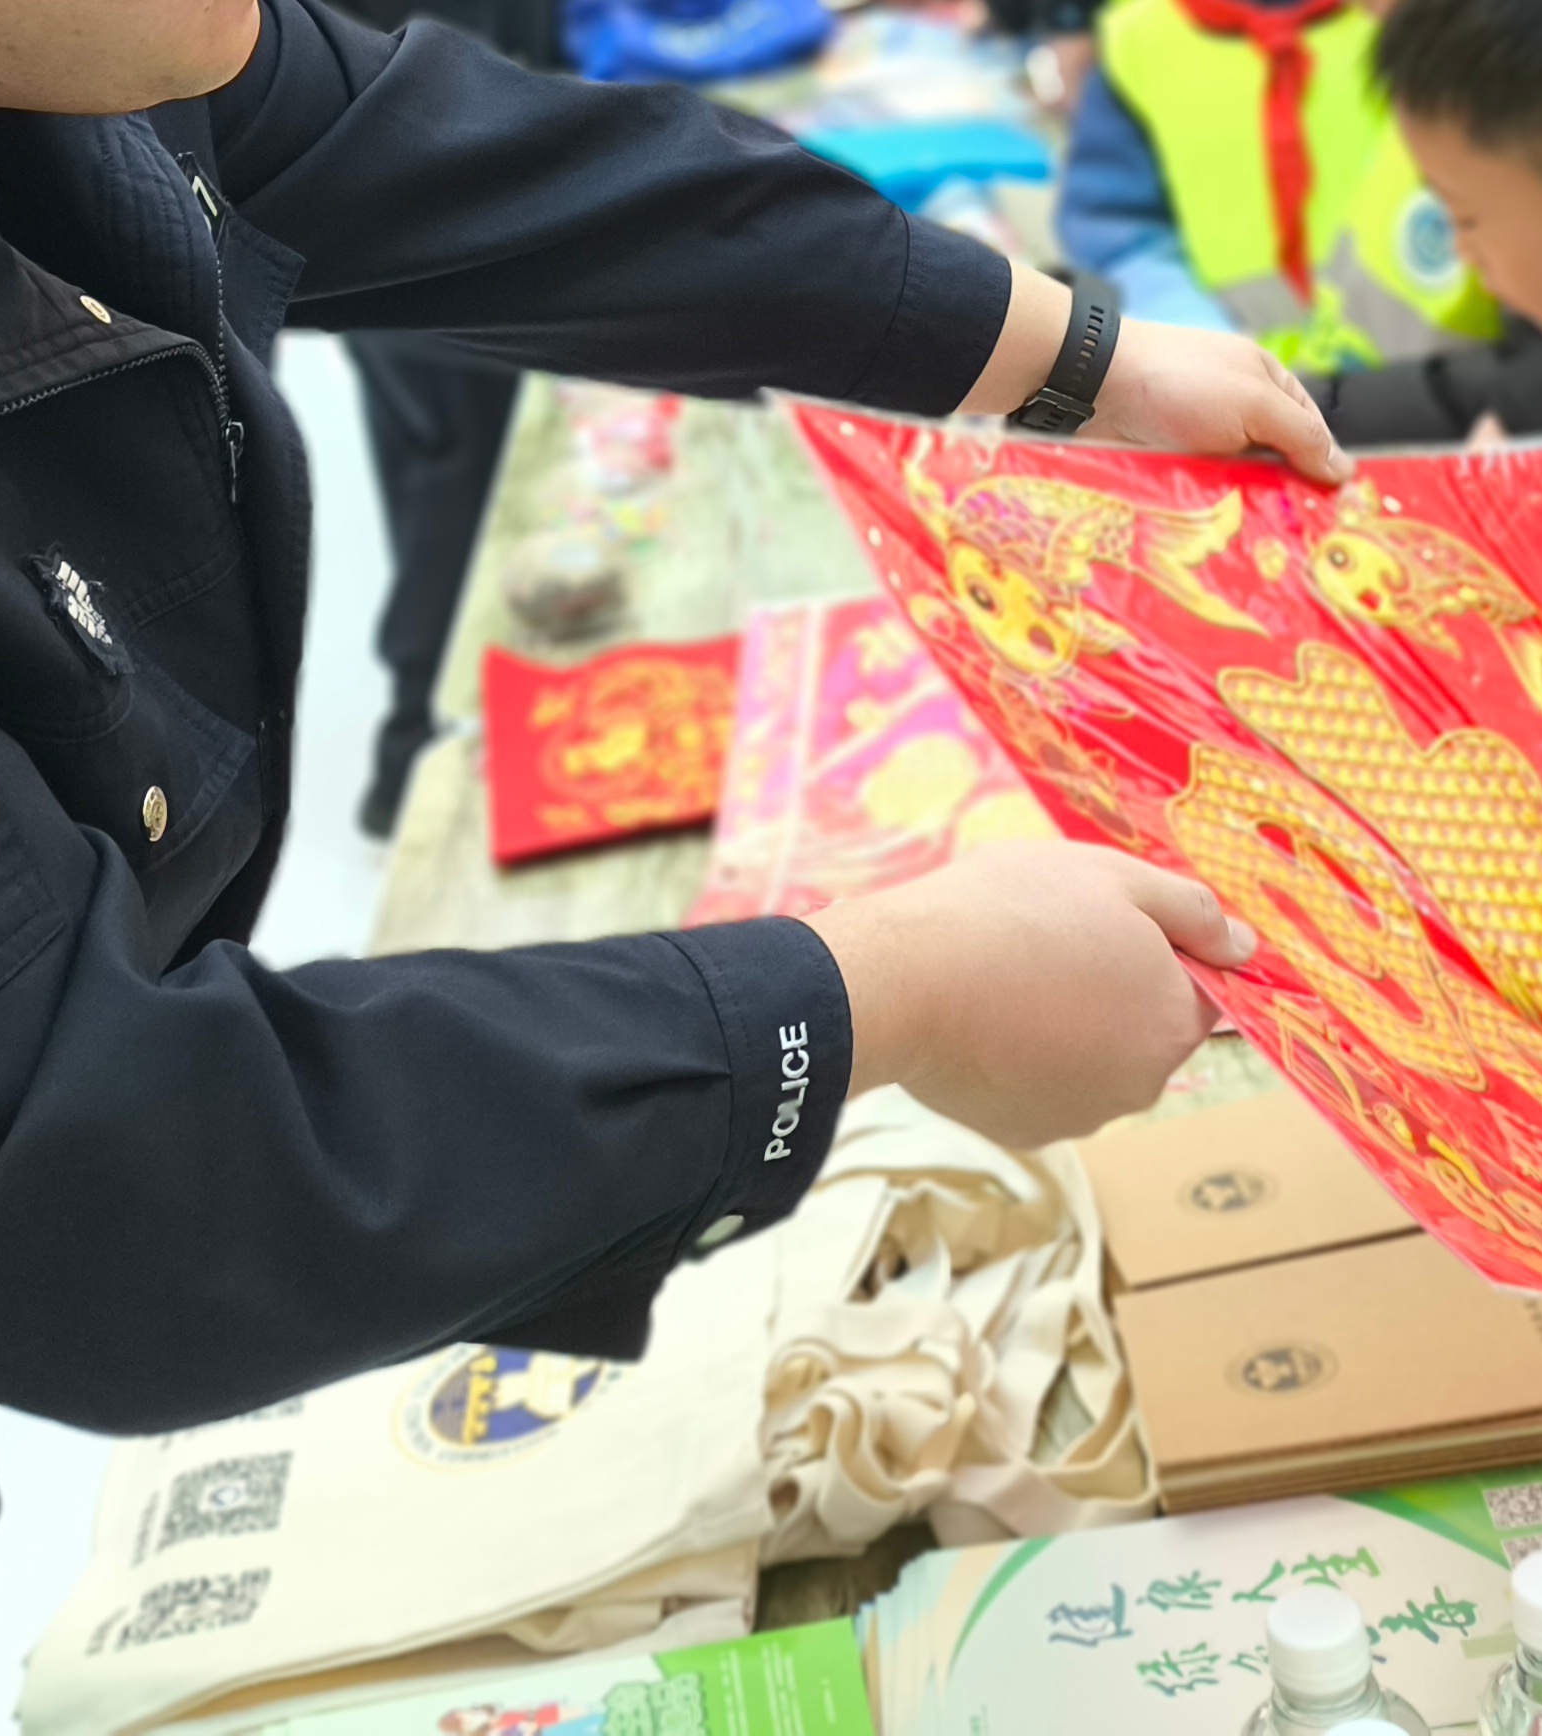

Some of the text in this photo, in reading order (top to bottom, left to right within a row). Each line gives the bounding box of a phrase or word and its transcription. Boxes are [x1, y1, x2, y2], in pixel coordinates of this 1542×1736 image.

[764, 1021, 810, 1162] POLICE
[1044, 1546, 1382, 1649] 健康人生
[1133, 1584, 1479, 1698] 绿毒
